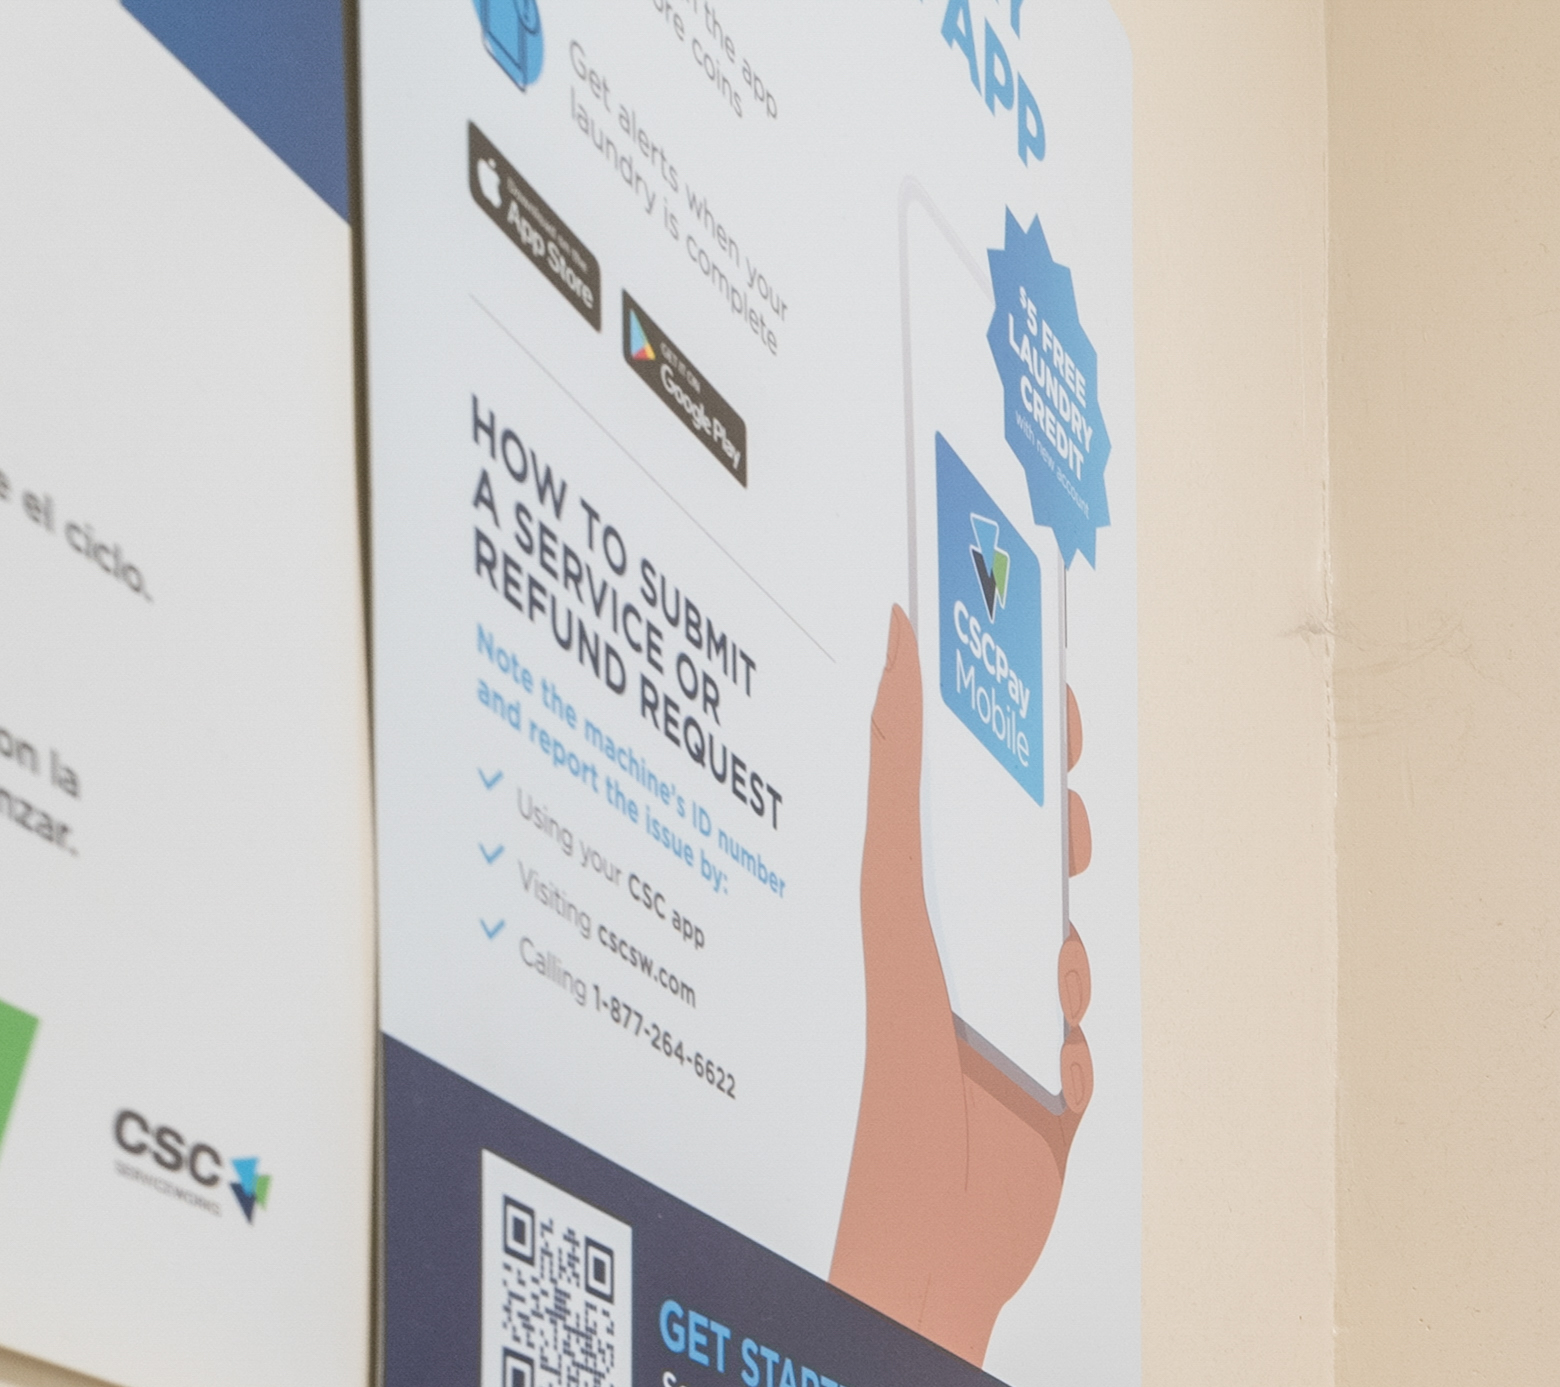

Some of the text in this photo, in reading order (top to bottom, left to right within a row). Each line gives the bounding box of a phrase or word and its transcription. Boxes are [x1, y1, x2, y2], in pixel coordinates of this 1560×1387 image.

[507, 200, 594, 309] App Store
[1008, 313, 1094, 454] LAUNDRY
[1019, 286, 1087, 409] $5 FREE
[660, 363, 741, 470] Google Play
[1020, 375, 1085, 481] CREDIT
[24, 487, 154, 604] el ciclo.
[471, 394, 757, 697] HOW TO SUBMIT
[472, 468, 720, 726] A SERVICE OR
[474, 527, 783, 830] REFUND REQUEST
[953, 600, 1031, 720] CSCPay
[956, 648, 1030, 768] Mobile
[517, 788, 705, 950] Using your CSC app
[518, 860, 696, 1008] Visiting cscsw.com
[519, 935, 736, 1100] Calling 1-877-264-6622
[113, 1109, 224, 1189] CSC
[659, 1299, 732, 1373] GET
